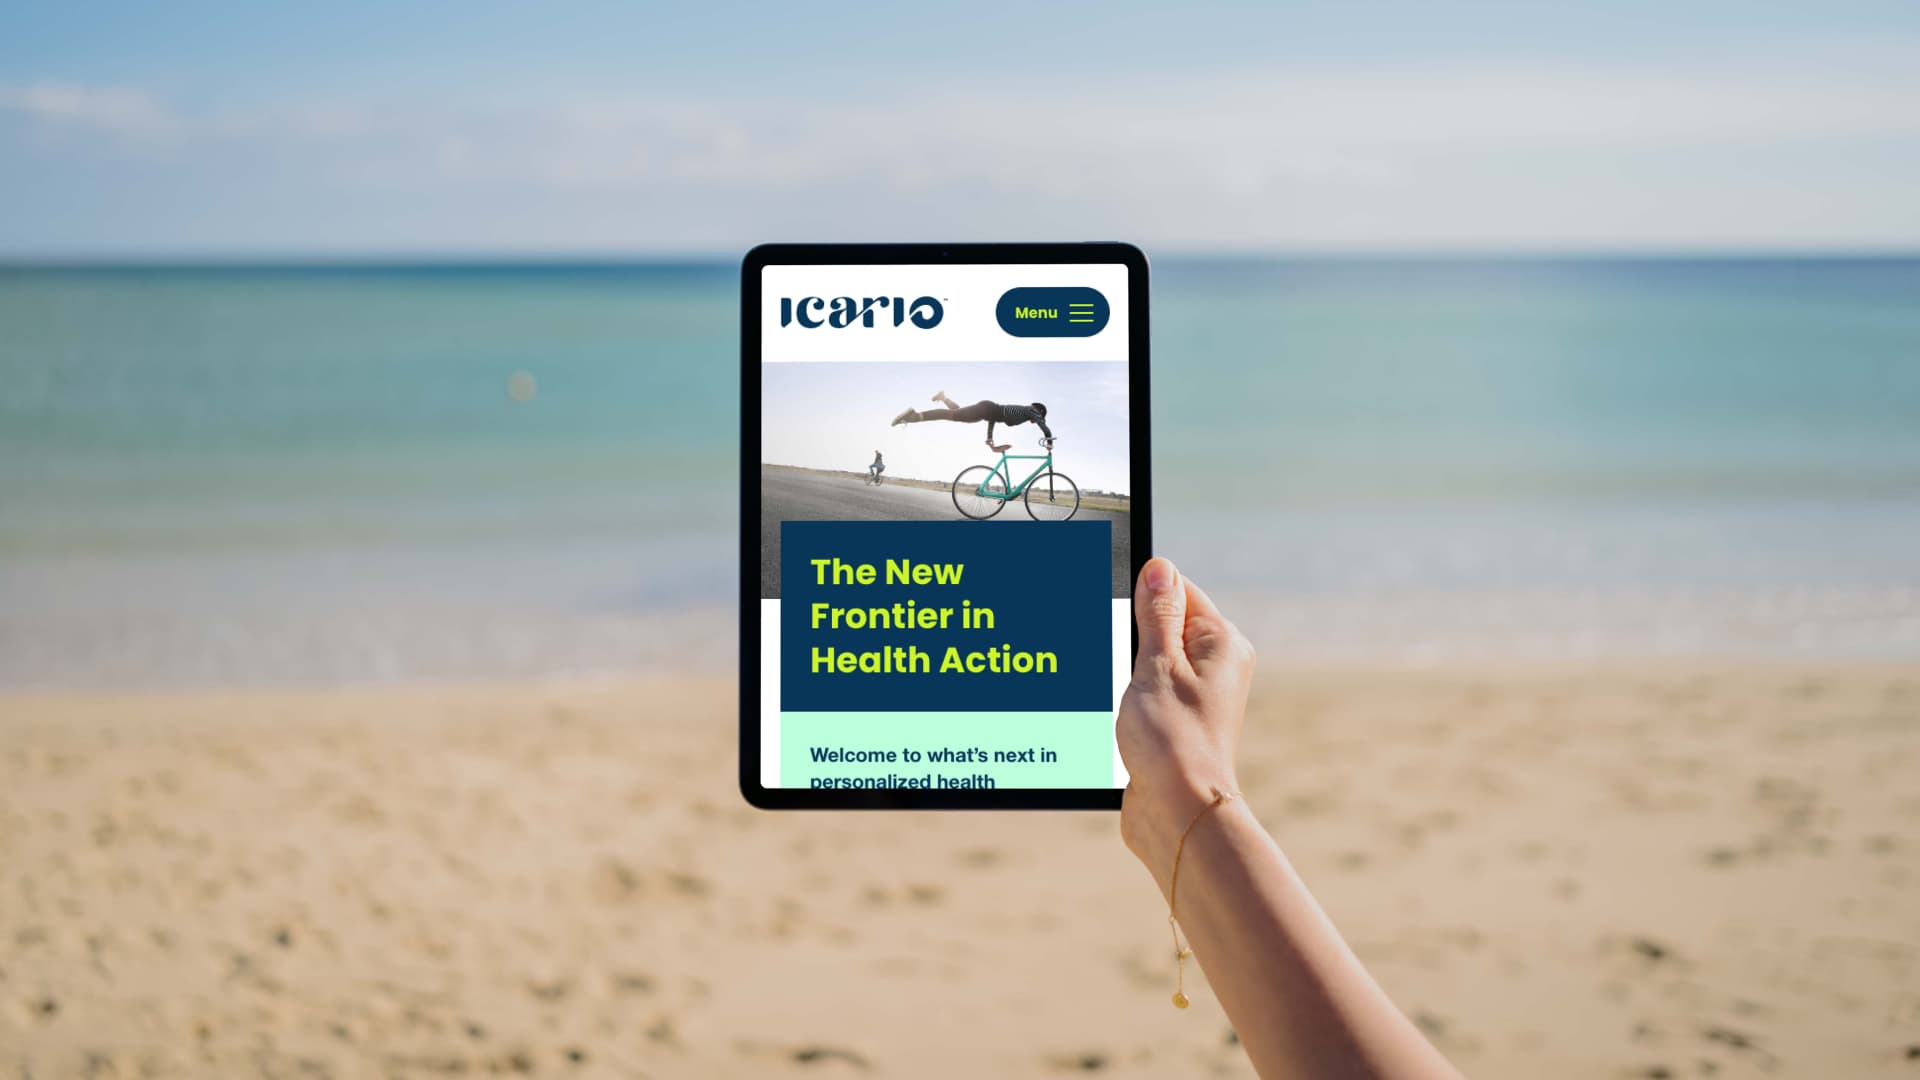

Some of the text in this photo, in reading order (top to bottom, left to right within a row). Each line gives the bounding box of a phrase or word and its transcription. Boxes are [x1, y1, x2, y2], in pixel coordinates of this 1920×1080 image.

[1015, 306, 1058, 319] Menu
[811, 558, 964, 585] The New
[811, 599, 995, 629] Frontier in
[811, 644, 1058, 673] Health Action
[810, 747, 1057, 763] Welcome to what’s next in
[810, 773, 995, 789] personalized health
